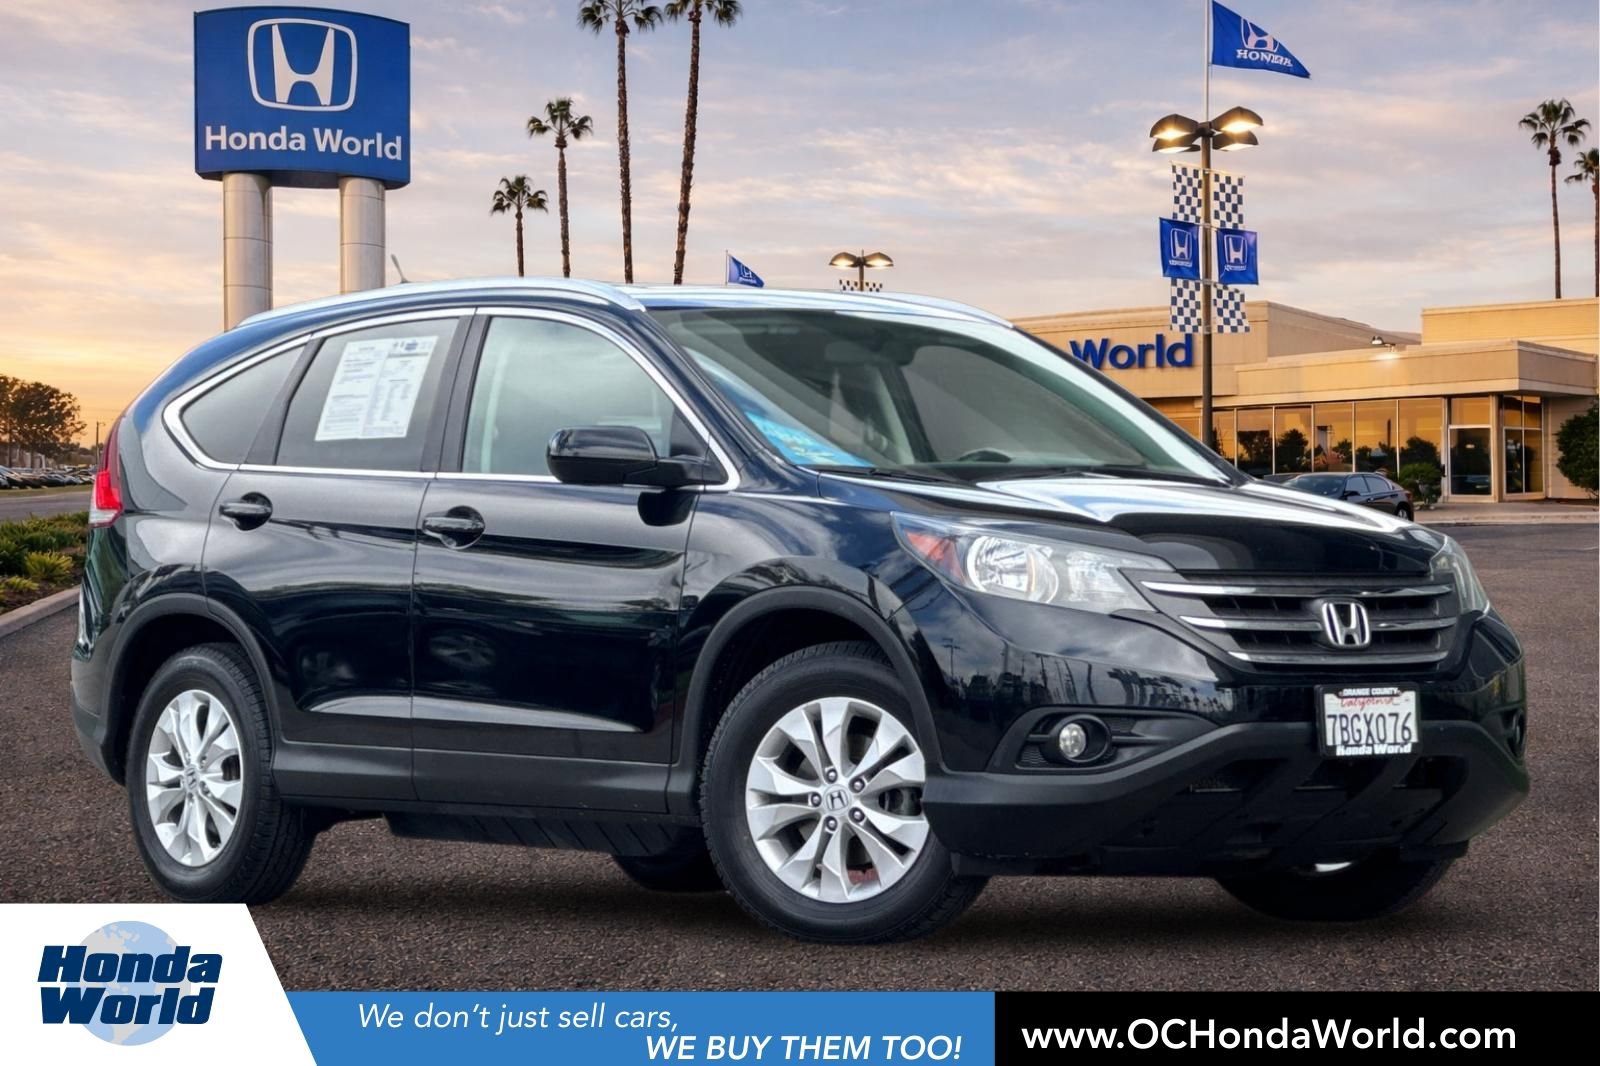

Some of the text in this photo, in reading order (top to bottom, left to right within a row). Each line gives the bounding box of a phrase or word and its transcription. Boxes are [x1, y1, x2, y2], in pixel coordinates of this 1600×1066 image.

[205, 125, 402, 160] Honda World
[1069, 333, 1194, 370] World
[1342, 687, 1399, 697] ORANGE COUNTY
[1326, 712, 1413, 745] 7BGX076
[1336, 743, 1412, 756] Honda World
